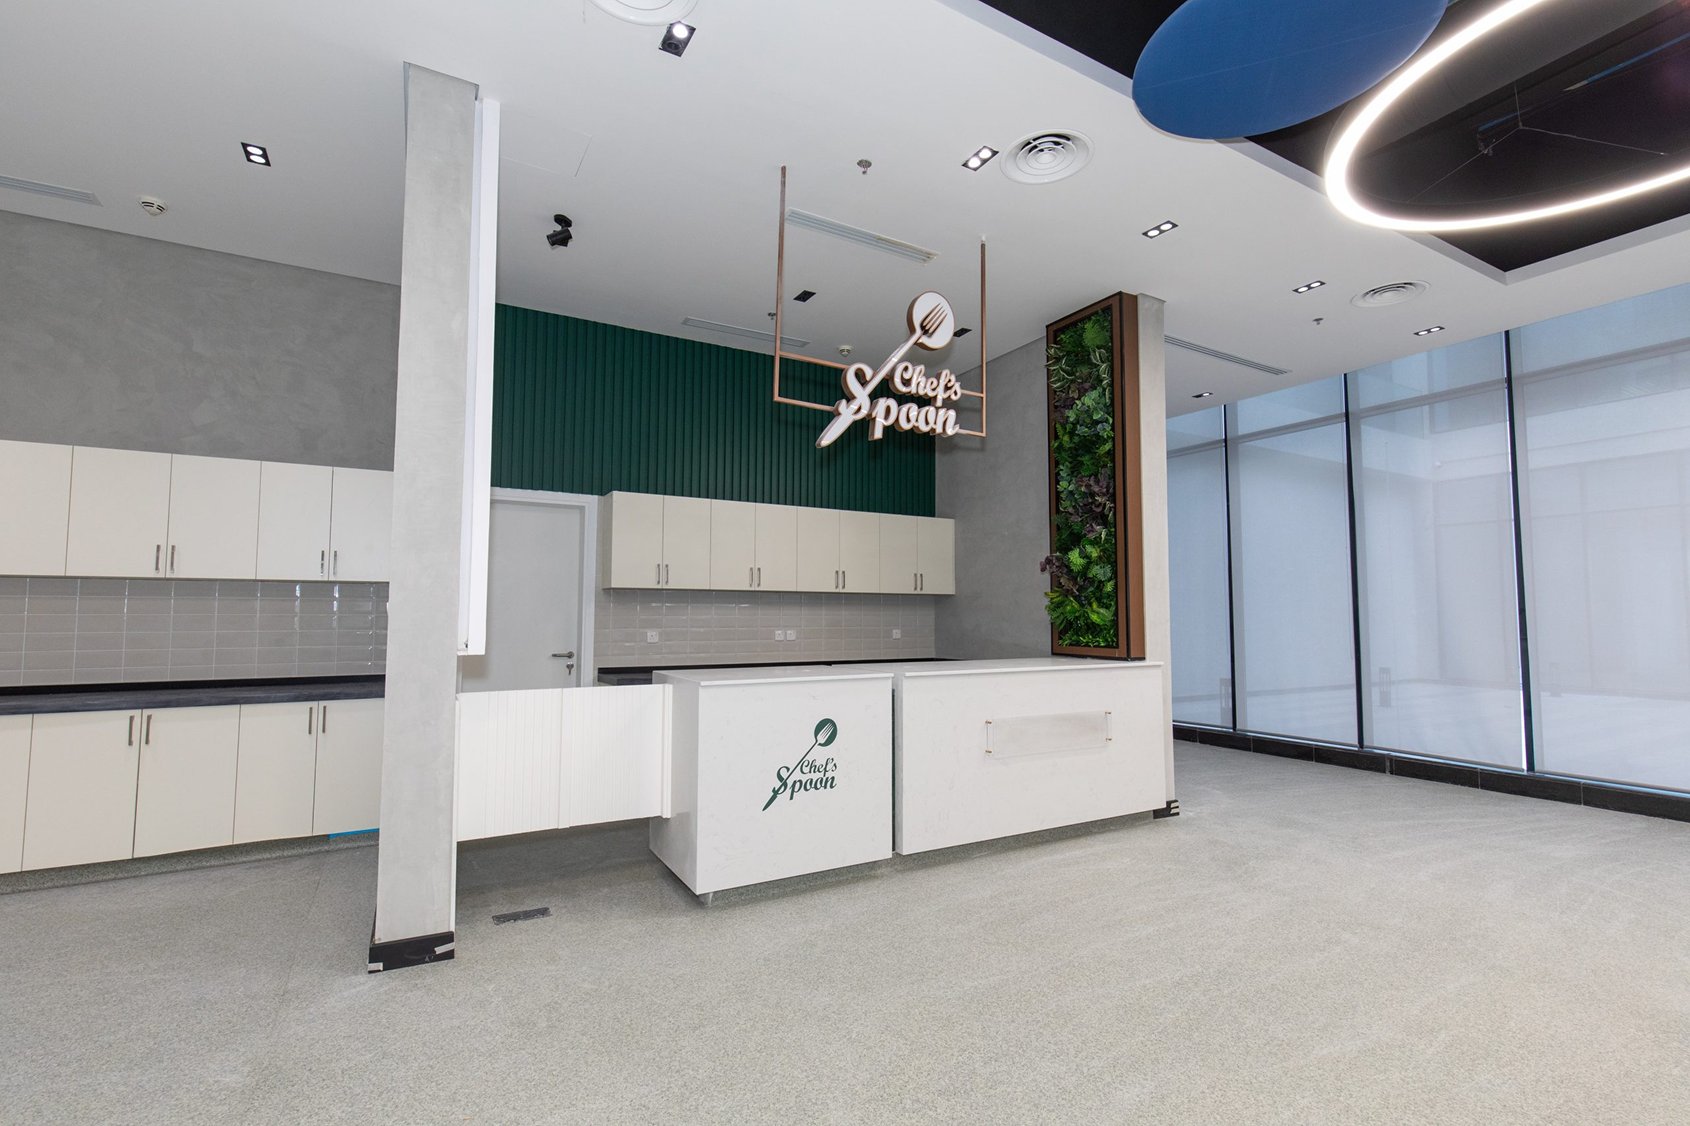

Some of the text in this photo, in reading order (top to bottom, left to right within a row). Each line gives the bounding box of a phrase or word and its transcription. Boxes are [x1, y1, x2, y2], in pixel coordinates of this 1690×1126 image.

[837, 362, 960, 441] Spoon
[890, 361, 962, 407] Chef's
[771, 765, 837, 801] Spoon
[799, 757, 838, 778] Chef's
